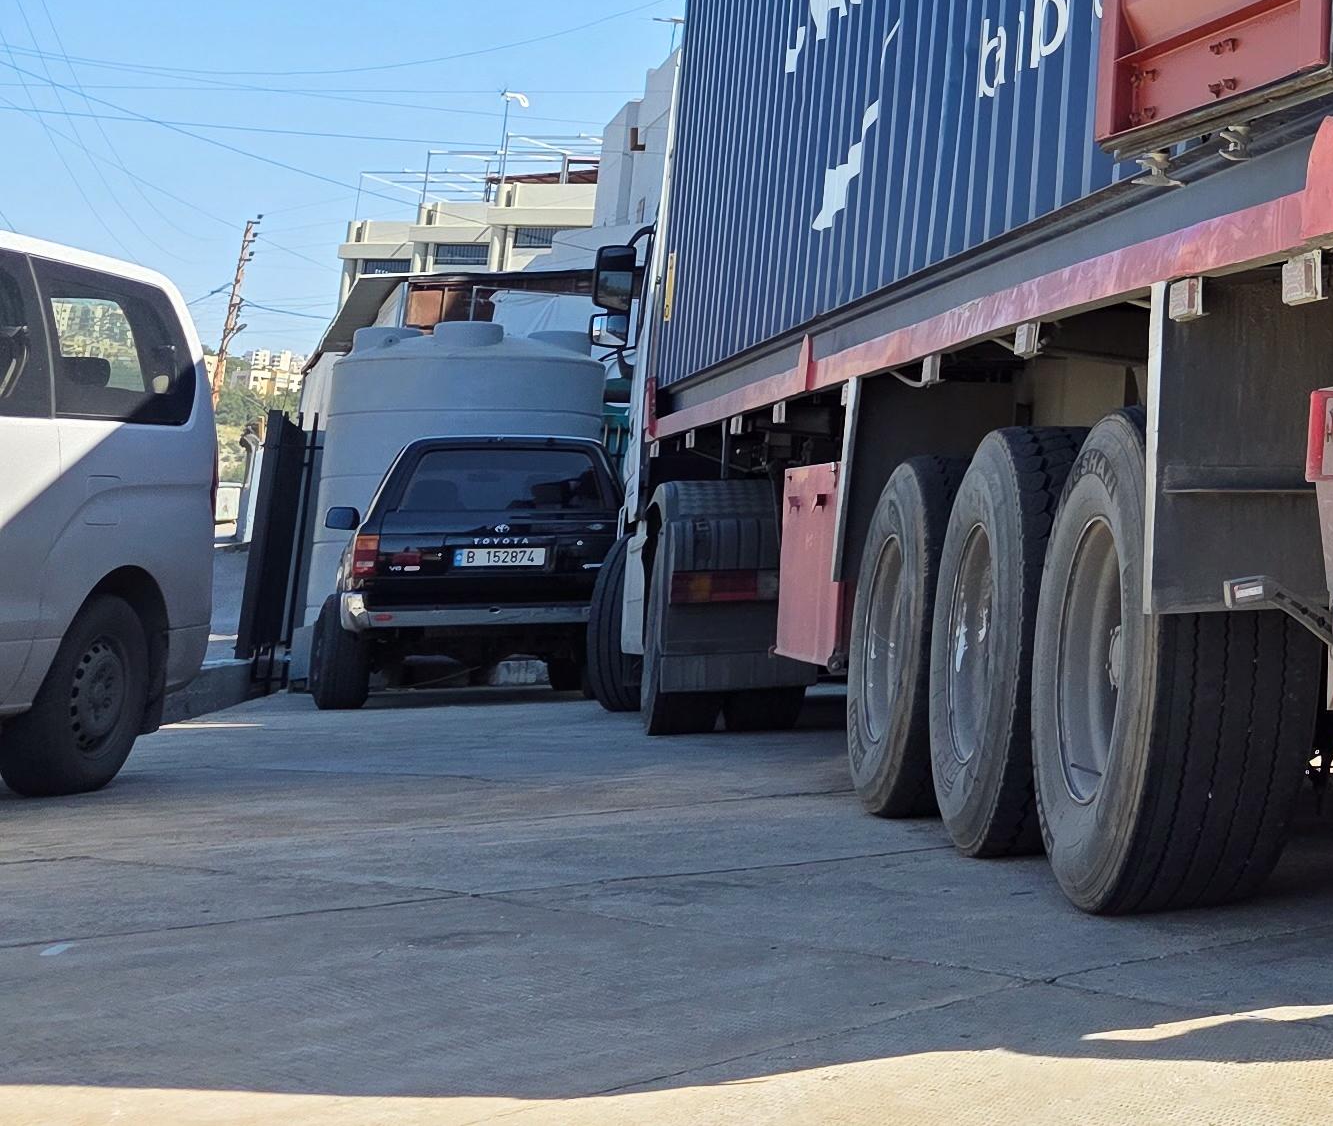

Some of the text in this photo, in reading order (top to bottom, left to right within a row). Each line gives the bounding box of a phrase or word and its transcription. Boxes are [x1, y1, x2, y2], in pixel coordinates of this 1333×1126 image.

[473, 537, 529, 545] TOYOTA
[466, 550, 535, 564] B 152874
